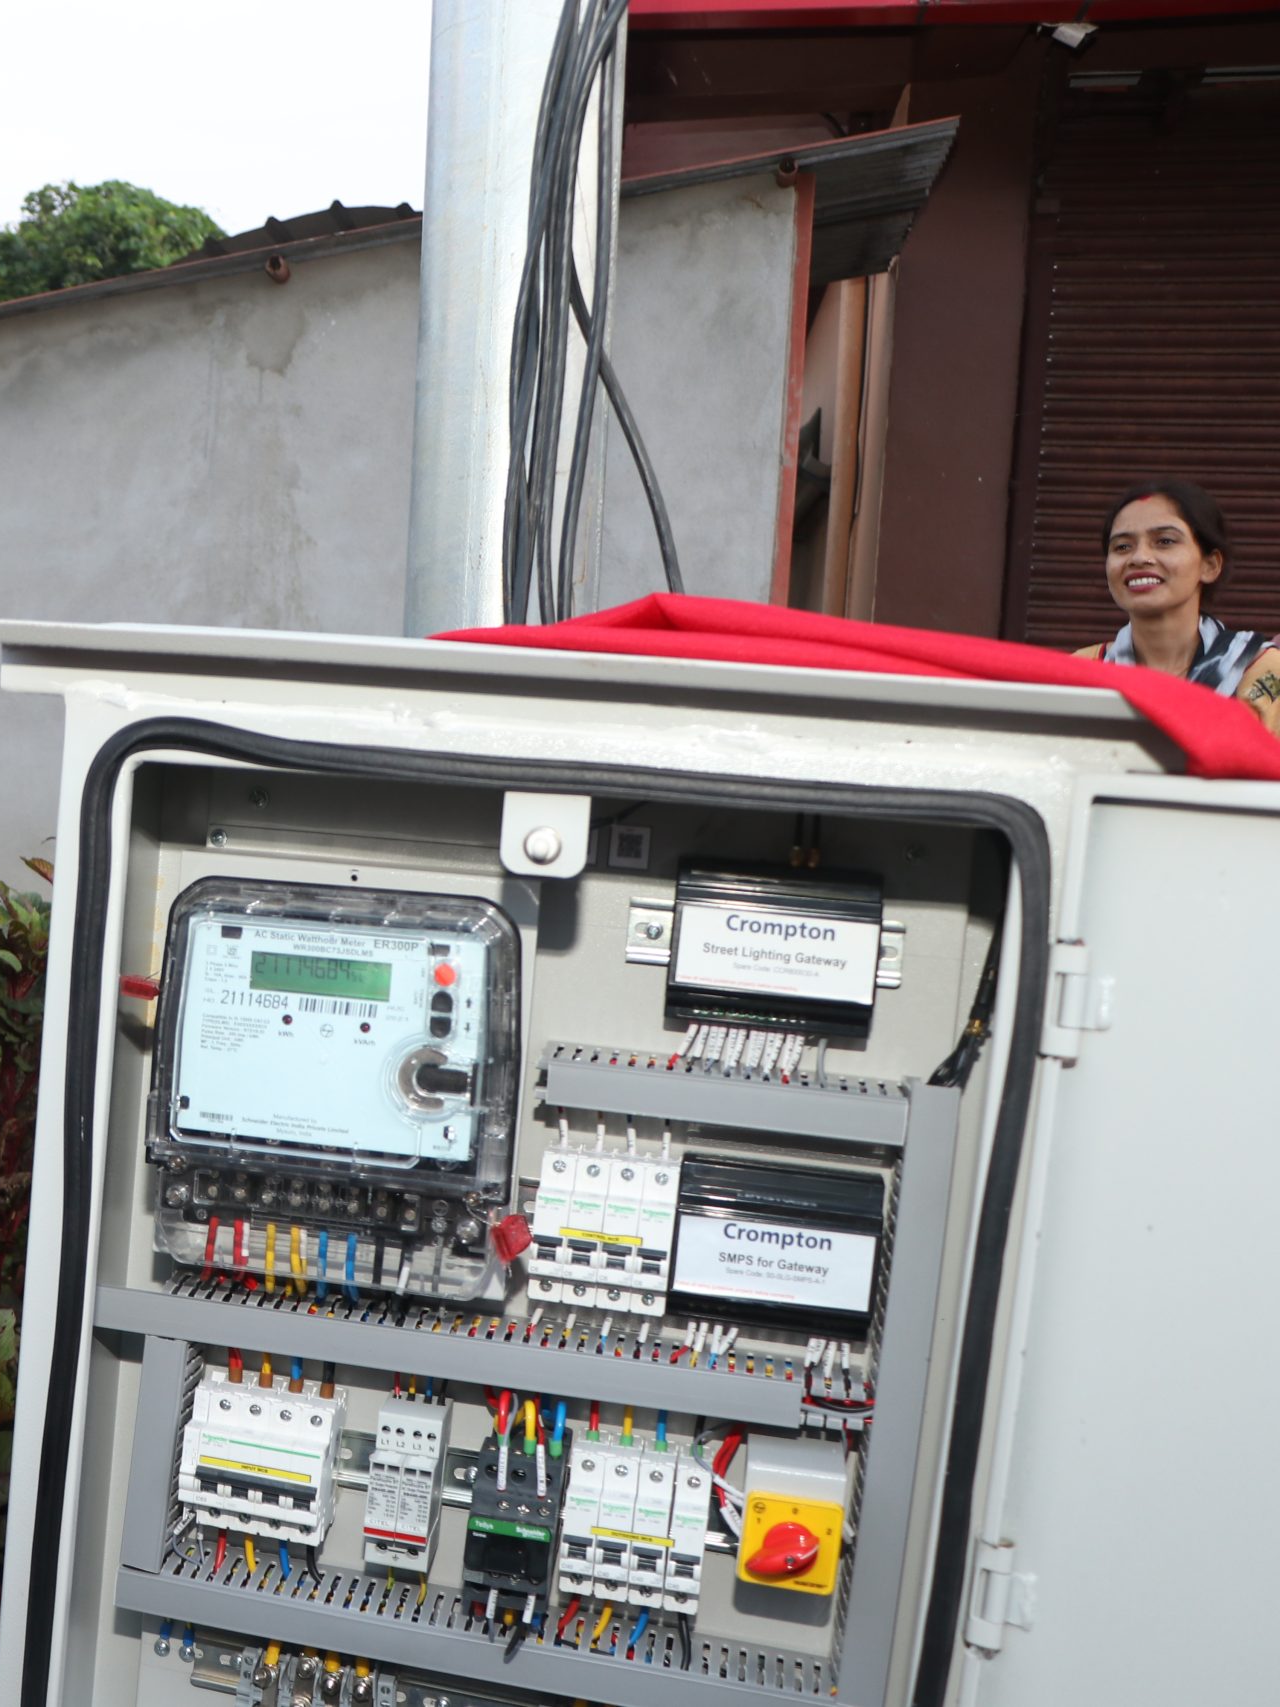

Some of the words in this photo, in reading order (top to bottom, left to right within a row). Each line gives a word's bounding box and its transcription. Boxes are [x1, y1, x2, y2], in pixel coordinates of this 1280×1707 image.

[725, 914, 835, 941] Crompton
[270, 931, 295, 941] Static
[341, 937, 365, 946] Meter
[374, 939, 419, 951] ER300P
[703, 942, 738, 956] Street
[741, 944, 790, 964] Lighting
[794, 952, 847, 969] Gateway
[221, 990, 288, 1009] 21114684
[723, 1223, 832, 1250] Crompton
[719, 1252, 753, 1266] SMPS
[757, 1257, 774, 1268] for
[777, 1260, 829, 1277] Gateway
